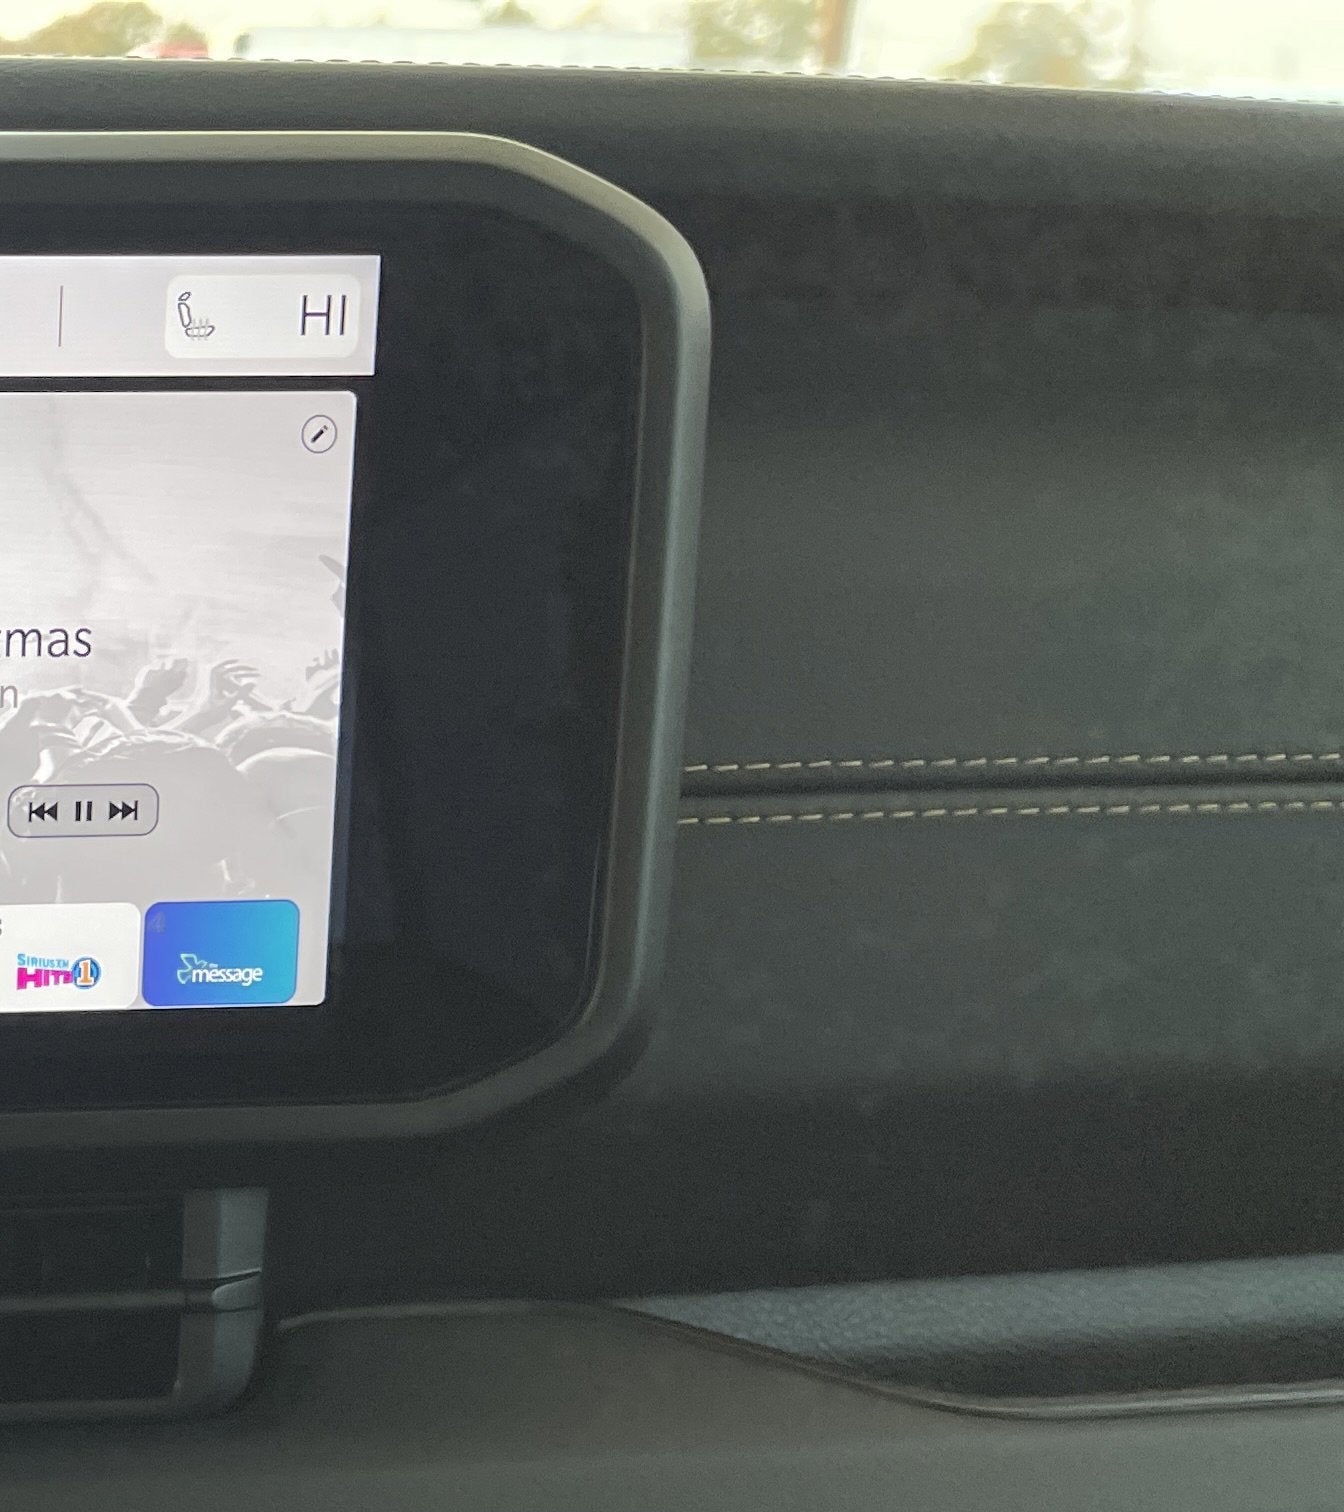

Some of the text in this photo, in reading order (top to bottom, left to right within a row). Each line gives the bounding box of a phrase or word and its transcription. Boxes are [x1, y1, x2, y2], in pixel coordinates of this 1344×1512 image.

[301, 294, 347, 336] HI
[76, 958, 96, 986] 1
[191, 966, 264, 986] message
